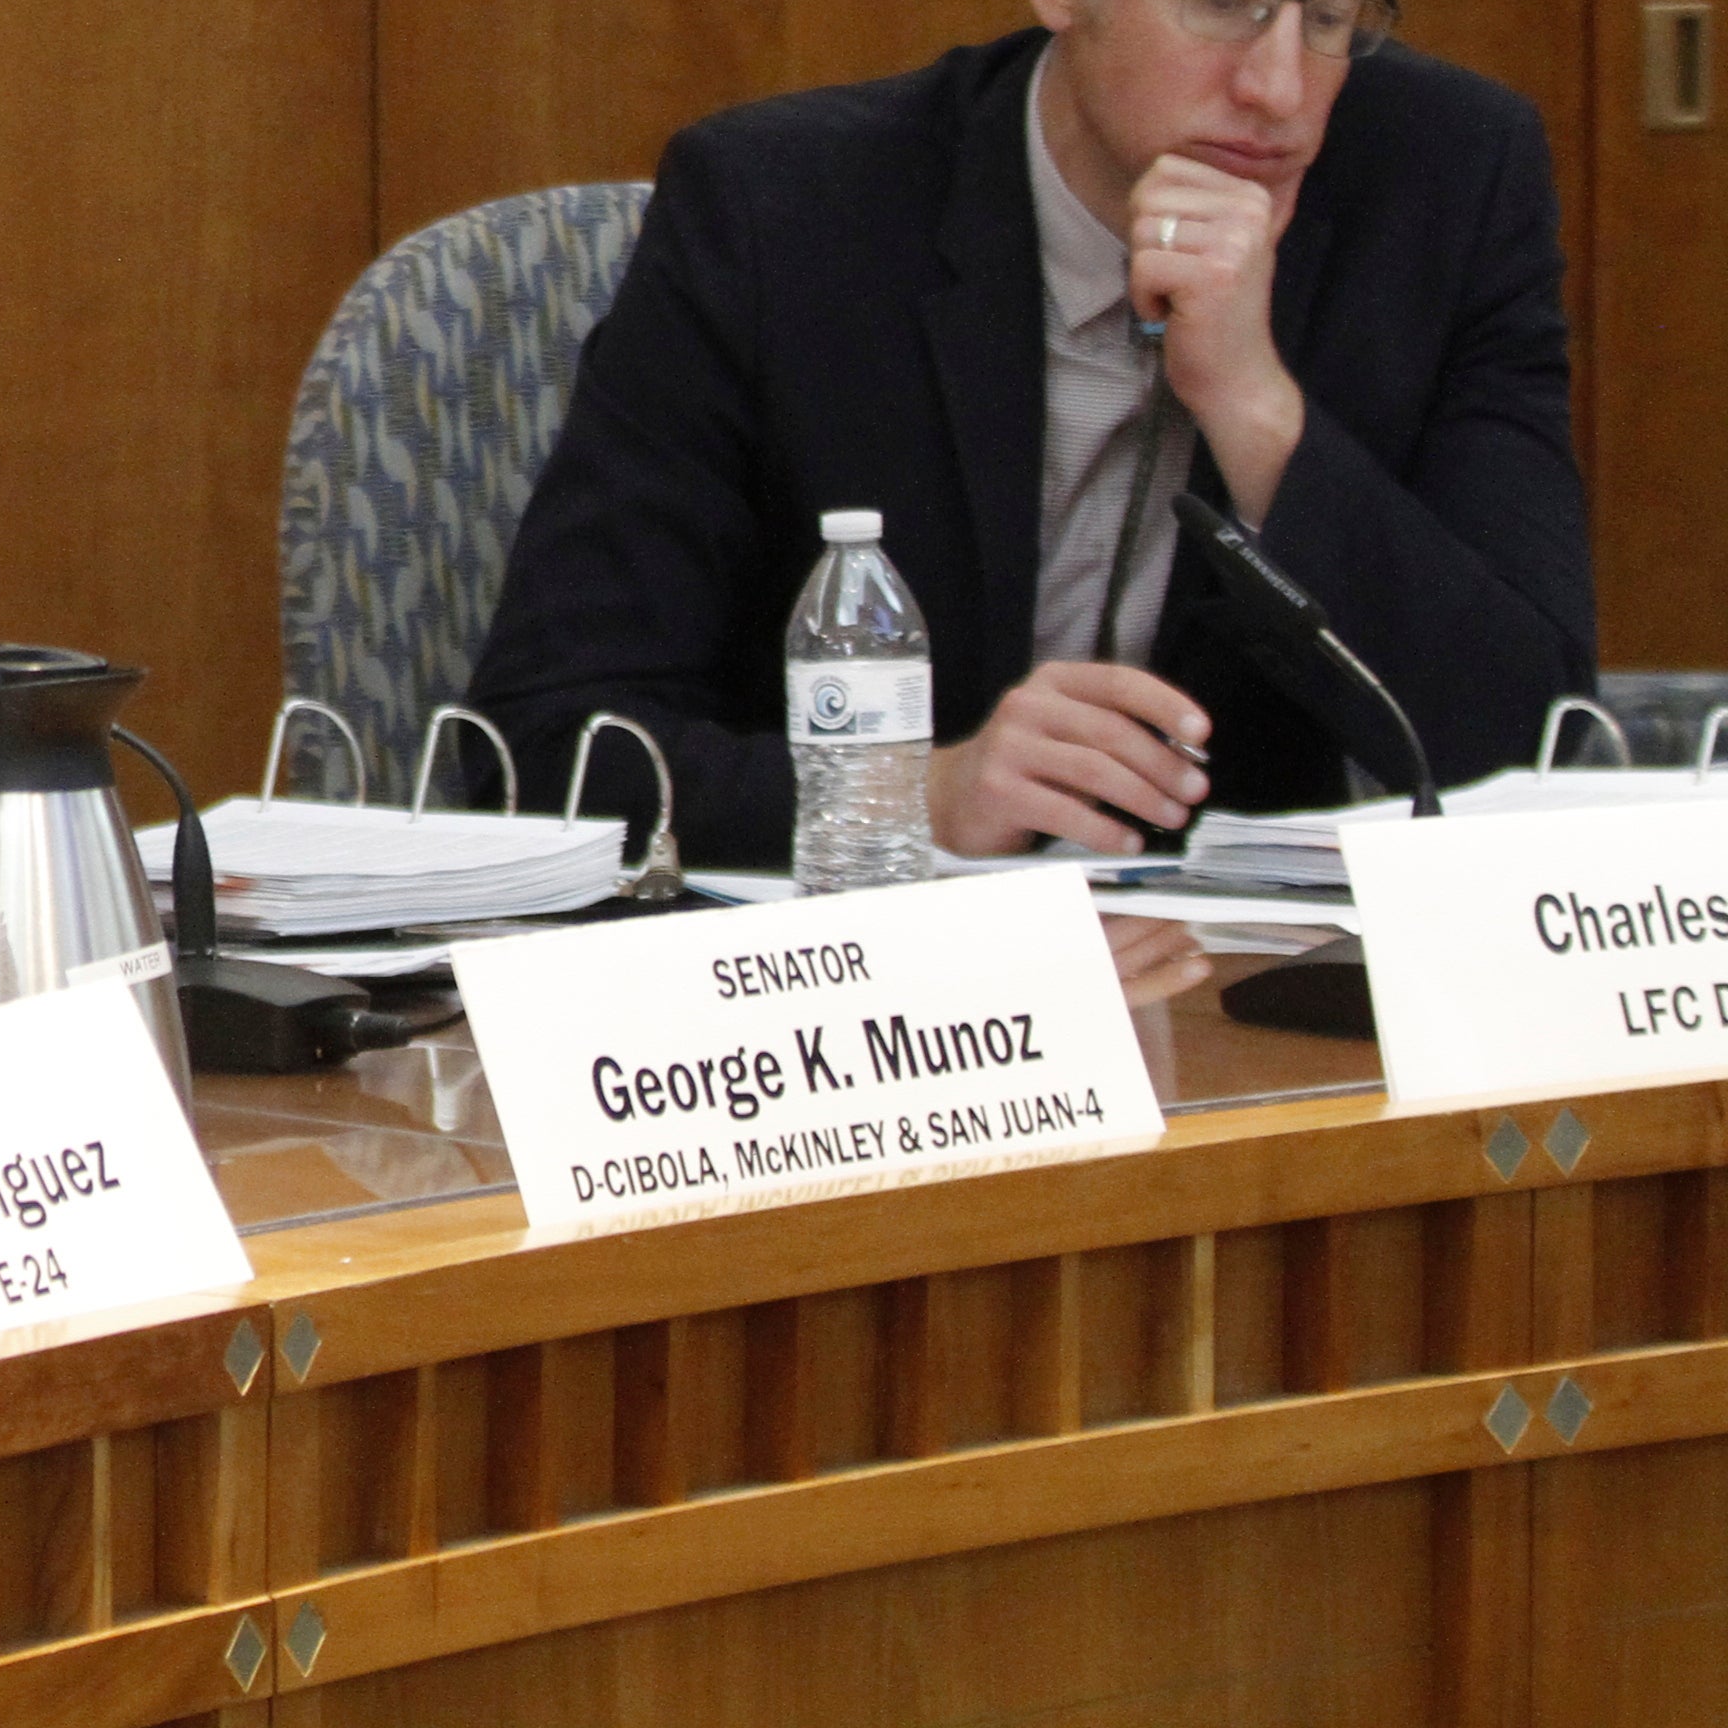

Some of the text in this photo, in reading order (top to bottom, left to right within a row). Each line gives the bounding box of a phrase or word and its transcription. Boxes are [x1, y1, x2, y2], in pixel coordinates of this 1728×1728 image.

[1534, 884, 1728, 955] Charles
[120, 954, 161, 977] WATER
[712, 942, 871, 1000] SENATOR
[1619, 985, 1702, 1037] LFC
[592, 1013, 1043, 1122] George K. Munoz
[571, 1146, 730, 1203] D-CIBOLA,
[734, 1120, 885, 1180] McKINLEY
[897, 1116, 923, 1154] &
[928, 1101, 993, 1148] SAN
[1000, 1088, 1106, 1139] JUAN-4
